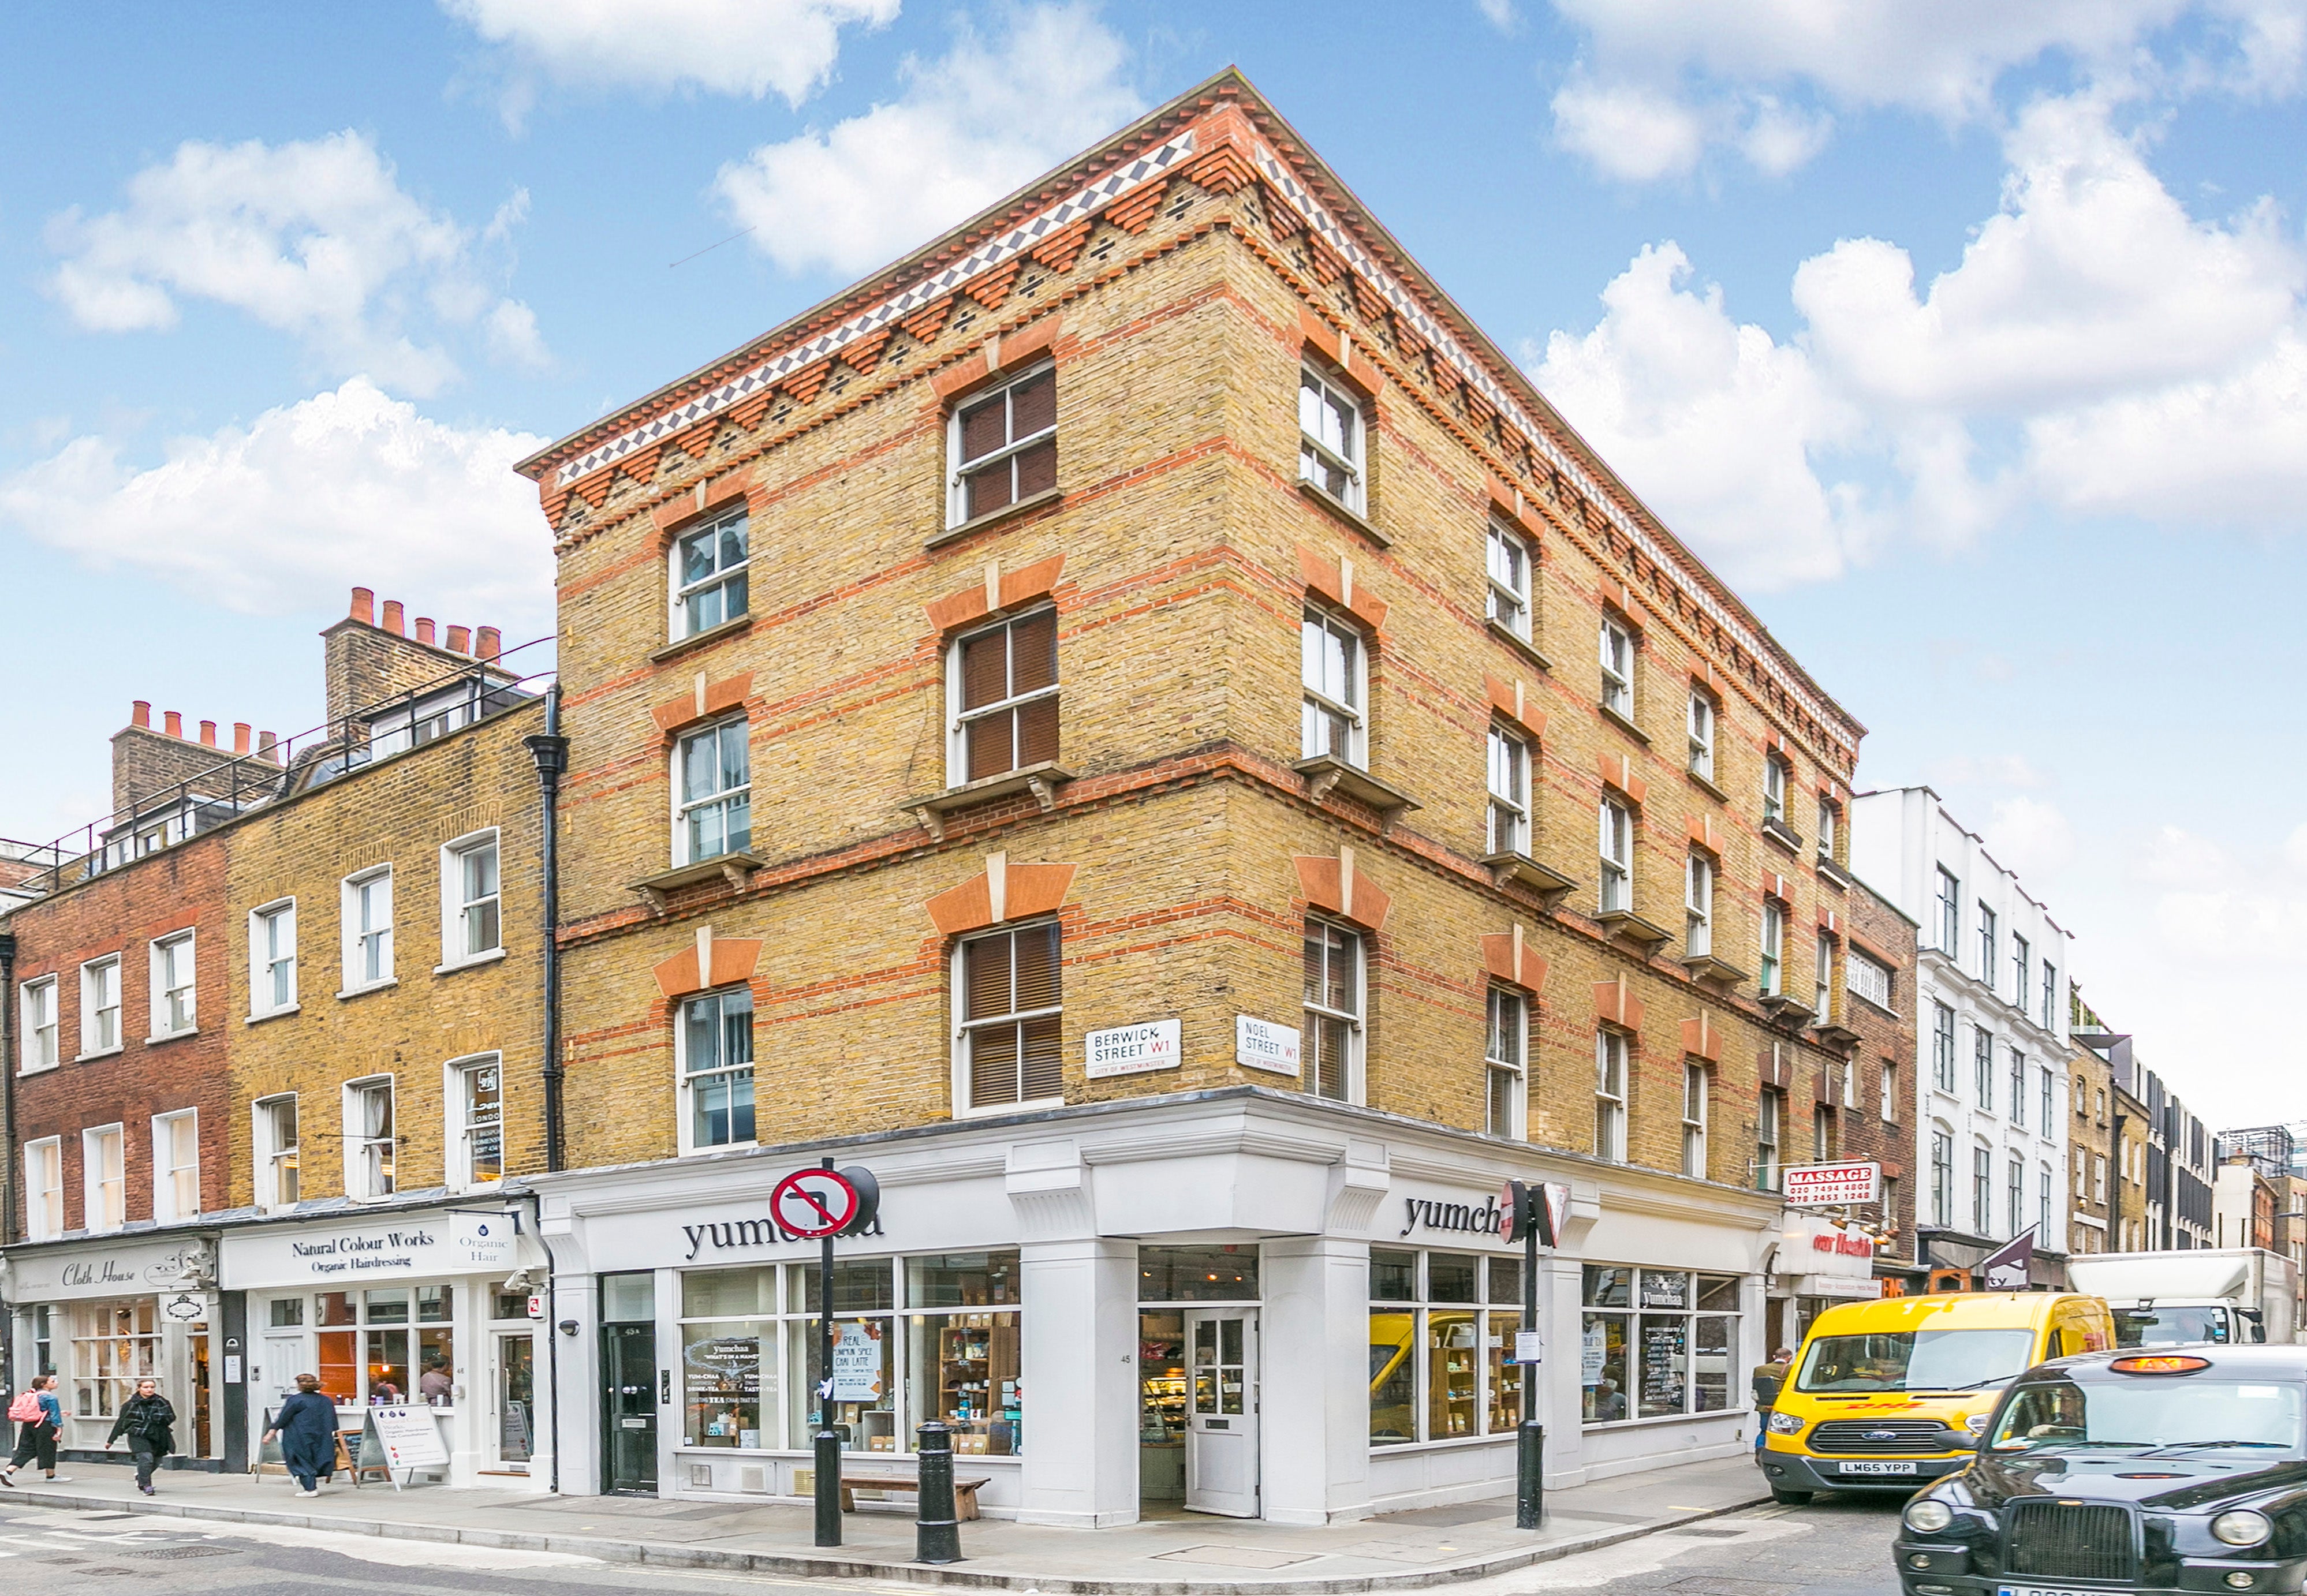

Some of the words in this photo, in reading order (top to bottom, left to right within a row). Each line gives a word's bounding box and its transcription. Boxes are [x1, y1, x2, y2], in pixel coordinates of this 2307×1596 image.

[1095, 1027, 1159, 1048] BERWICK
[1246, 1022, 1270, 1038] NOEL
[1095, 1044, 1144, 1061] STREET
[1151, 1040, 1170, 1053] W1
[1246, 1037, 1279, 1055] STREET
[1285, 1046, 1296, 1059] W1
[1121, 1060, 1165, 1071] WESTMINSTER
[1263, 1060, 1291, 1071] WESTMINSTER
[471, 1112, 500, 1124] LONDO
[1790, 1168, 1871, 1184] MASSAGE
[1401, 1195, 1500, 1236] yumch
[293, 1239, 336, 1257] Natural
[340, 1237, 384, 1253] Colour
[388, 1231, 434, 1249] Works
[460, 1236, 509, 1249] Organic
[682, 1217, 885, 1260] yuma
[311, 1258, 346, 1273] Organic
[350, 1255, 412, 1270] Hairdressing
[471, 1251, 499, 1262] Hair
[62, 1263, 92, 1287] Cloth
[94, 1260, 136, 1284] House
[1643, 1290, 1683, 1309] yumchaa
[843, 1335, 861, 1345] REAL
[713, 1344, 749, 1355] yumchaa
[833, 1348, 855, 1356] UMPKIN
[858, 1347, 872, 1356] SPICE
[835, 1357, 849, 1366] CHAI
[852, 1356, 869, 1366] LATTE
[1121, 1355, 1130, 1363] 45
[2130, 1357, 2185, 1372] TAXI
[1845, 1463, 1880, 1472] LM65
[1884, 1463, 1910, 1472] YPP
